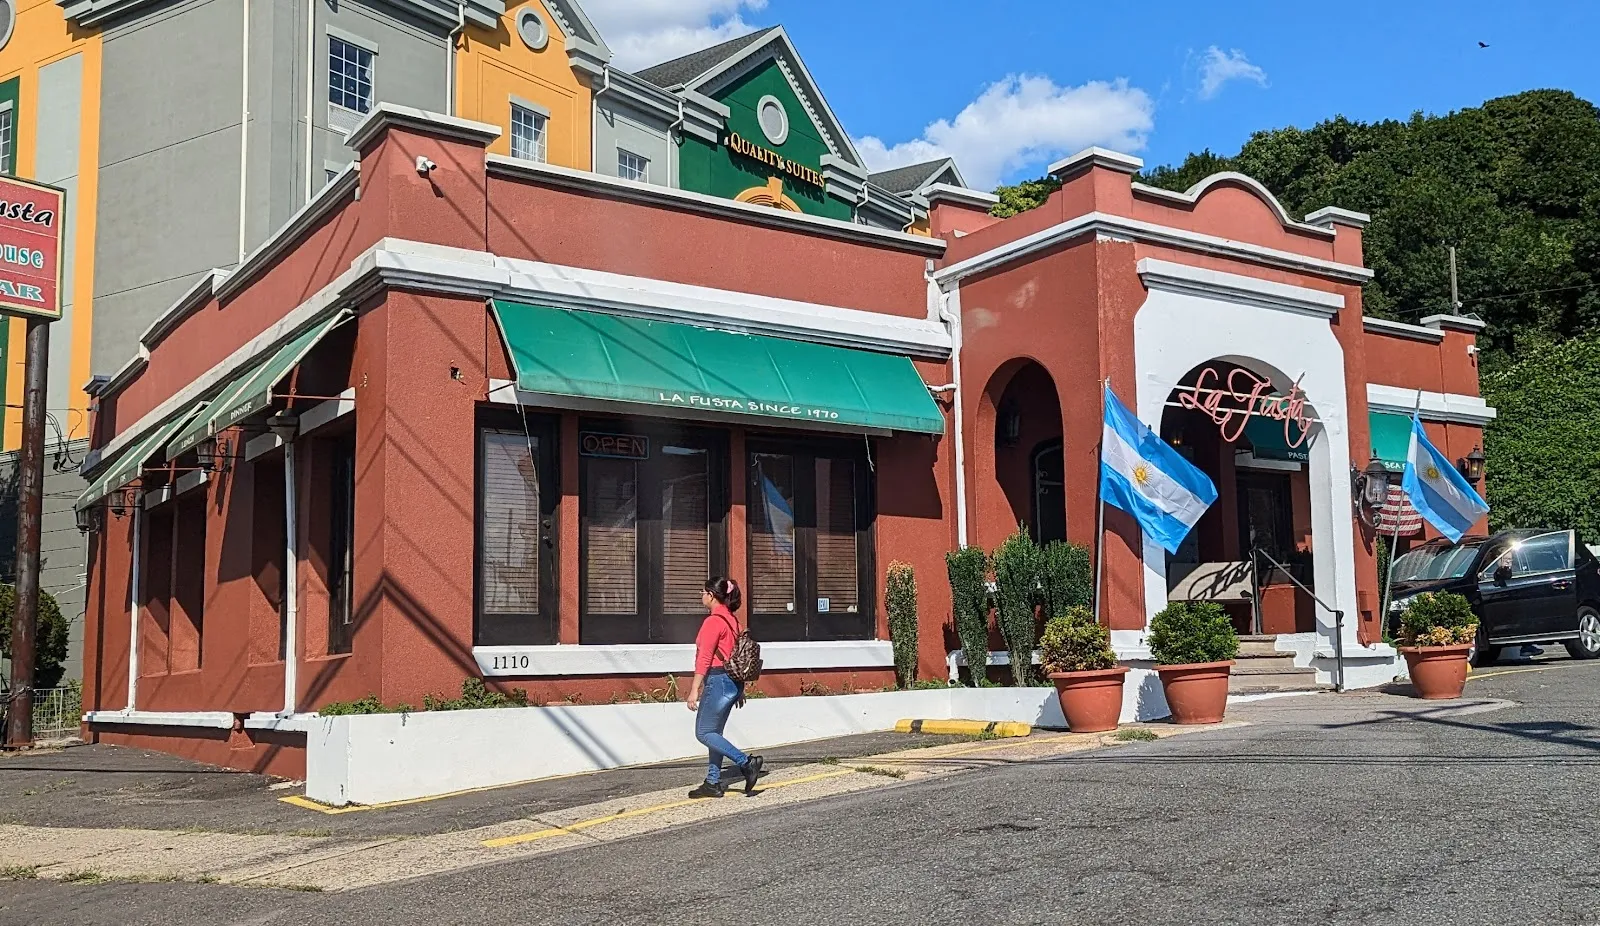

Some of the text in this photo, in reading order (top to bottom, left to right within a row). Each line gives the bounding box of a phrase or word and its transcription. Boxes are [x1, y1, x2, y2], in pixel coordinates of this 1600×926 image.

[730, 132, 825, 188] QUALITY SUITES
[0, 244, 44, 268] use
[659, 392, 839, 419] LA FUSTA SINCE 1970
[583, 435, 646, 456] OPEN
[1287, 451, 1309, 461] PAST
[1384, 461, 1401, 469] SEA
[492, 655, 529, 670] 1110
